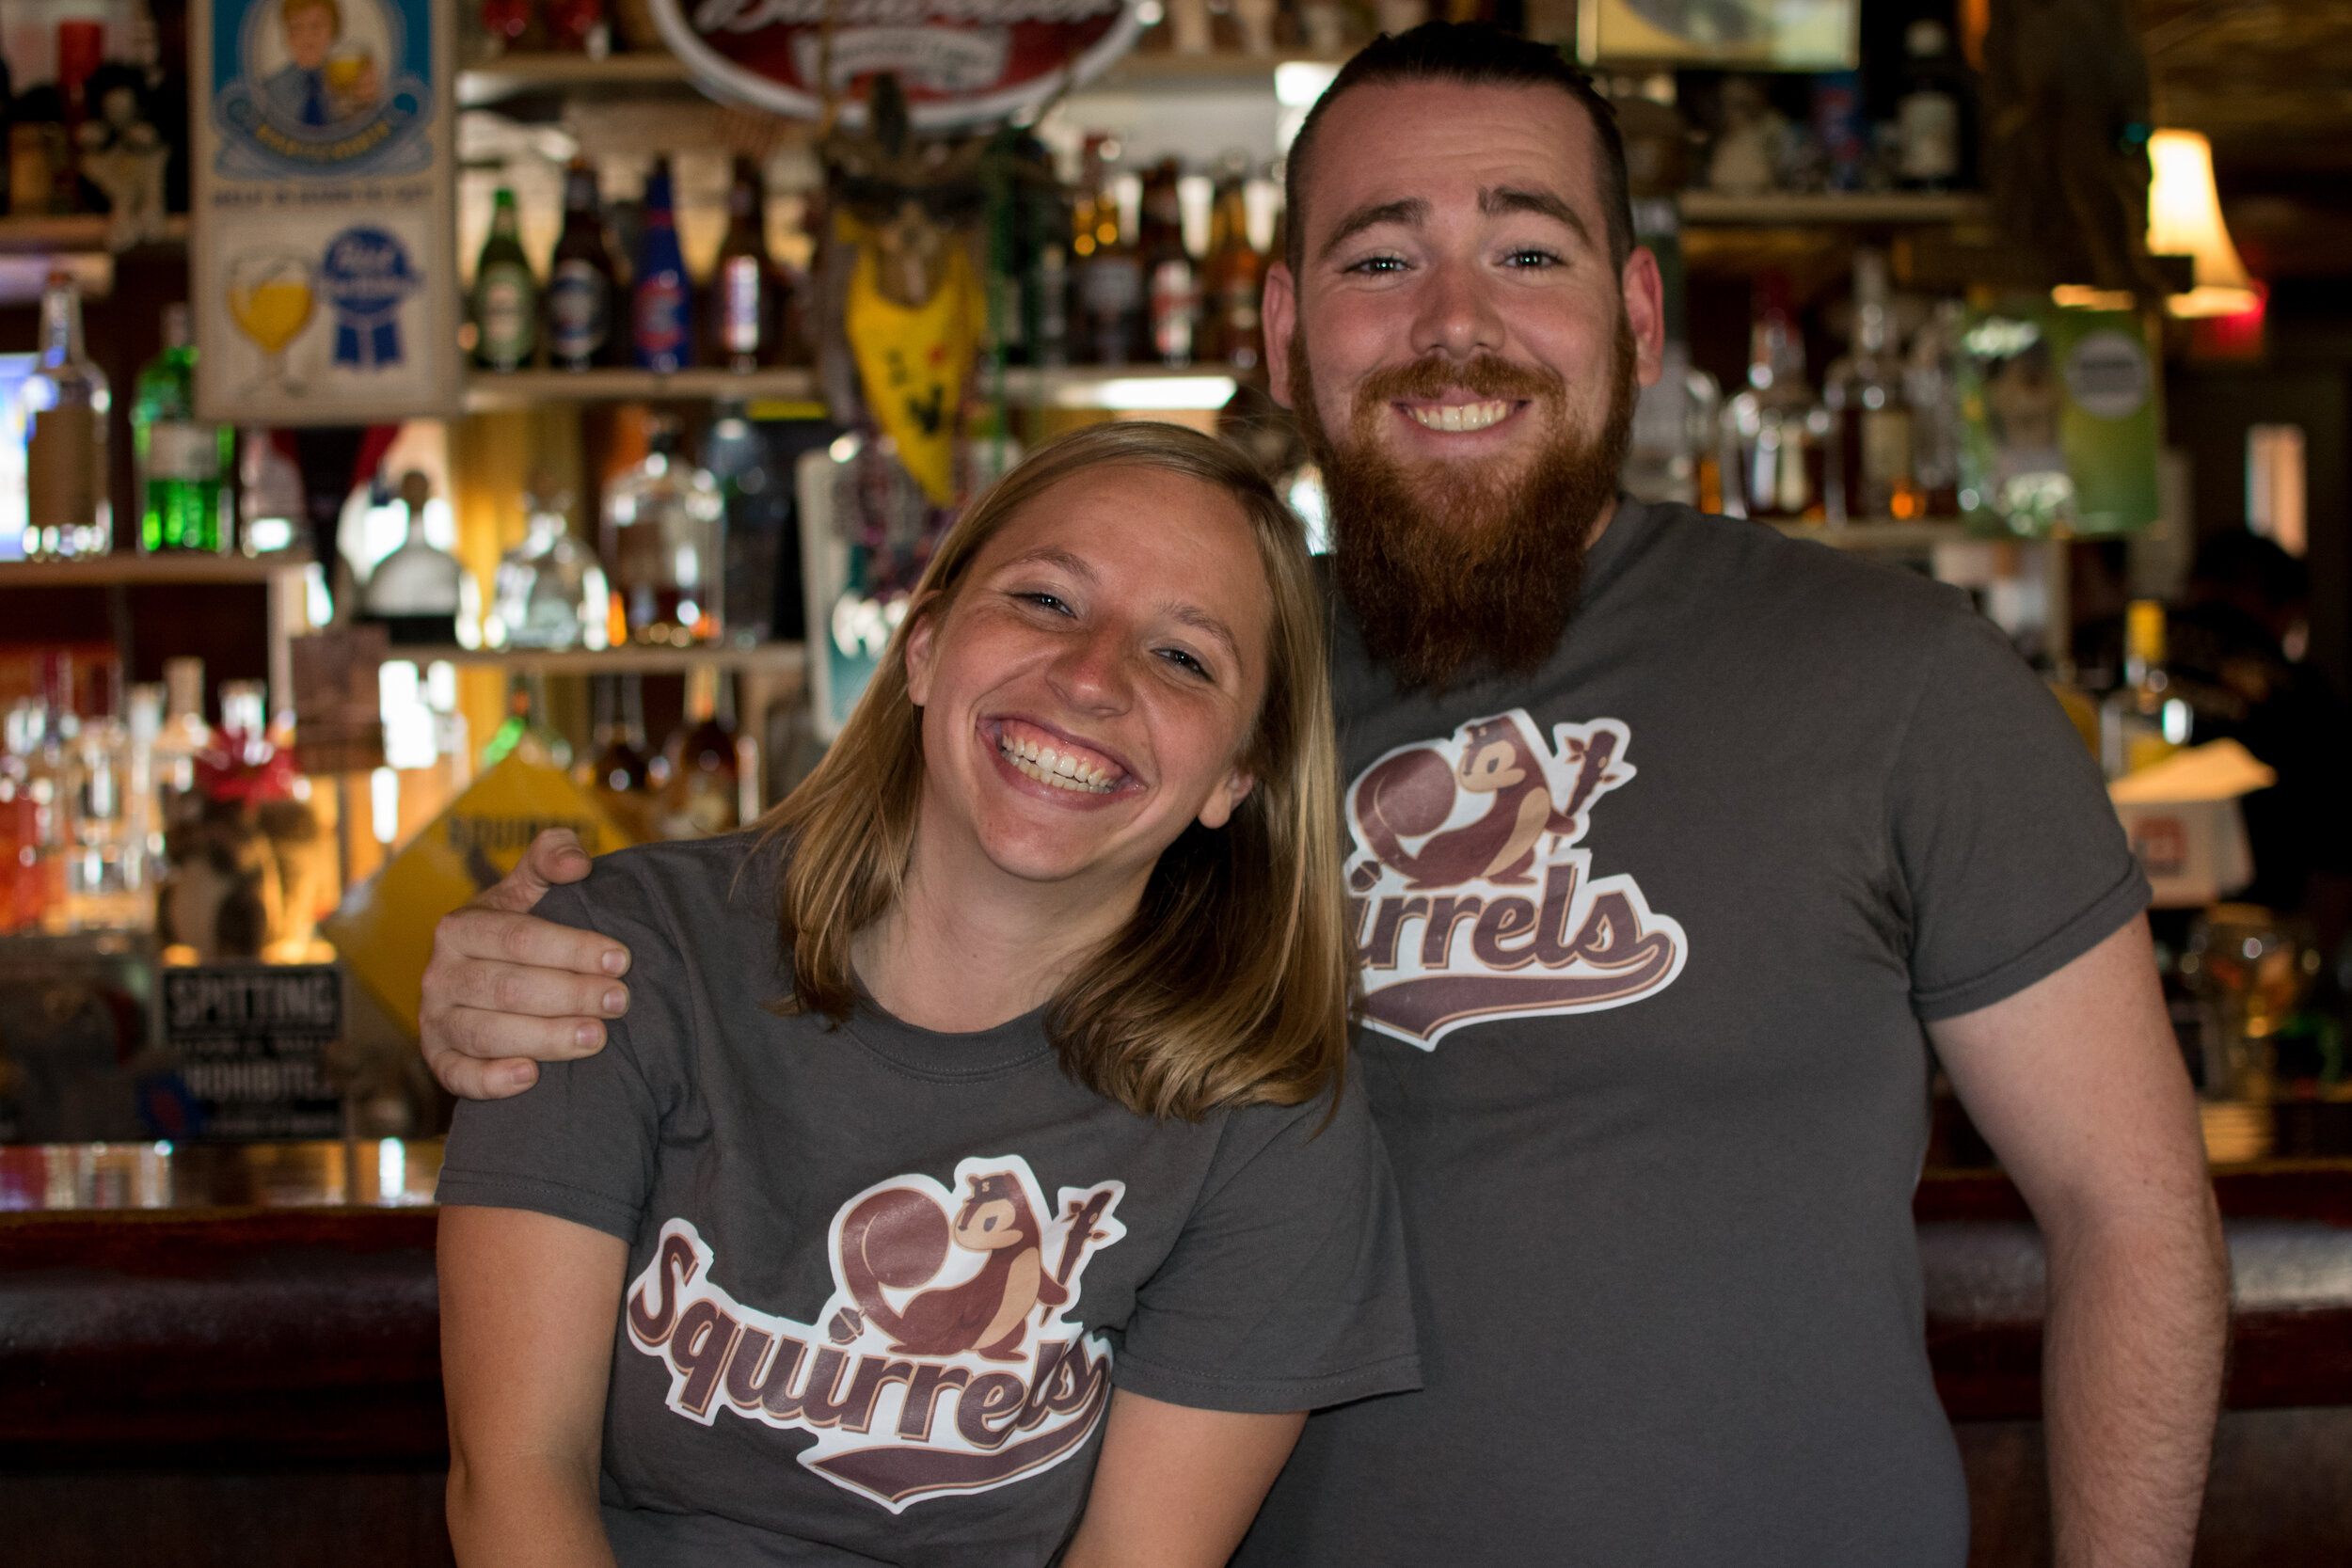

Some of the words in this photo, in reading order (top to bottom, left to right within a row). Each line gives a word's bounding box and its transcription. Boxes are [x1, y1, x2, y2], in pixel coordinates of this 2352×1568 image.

[1349, 861, 1676, 972] irrels
[981, 1180, 991, 1193] S
[629, 1231, 1110, 1451] Squirrels
